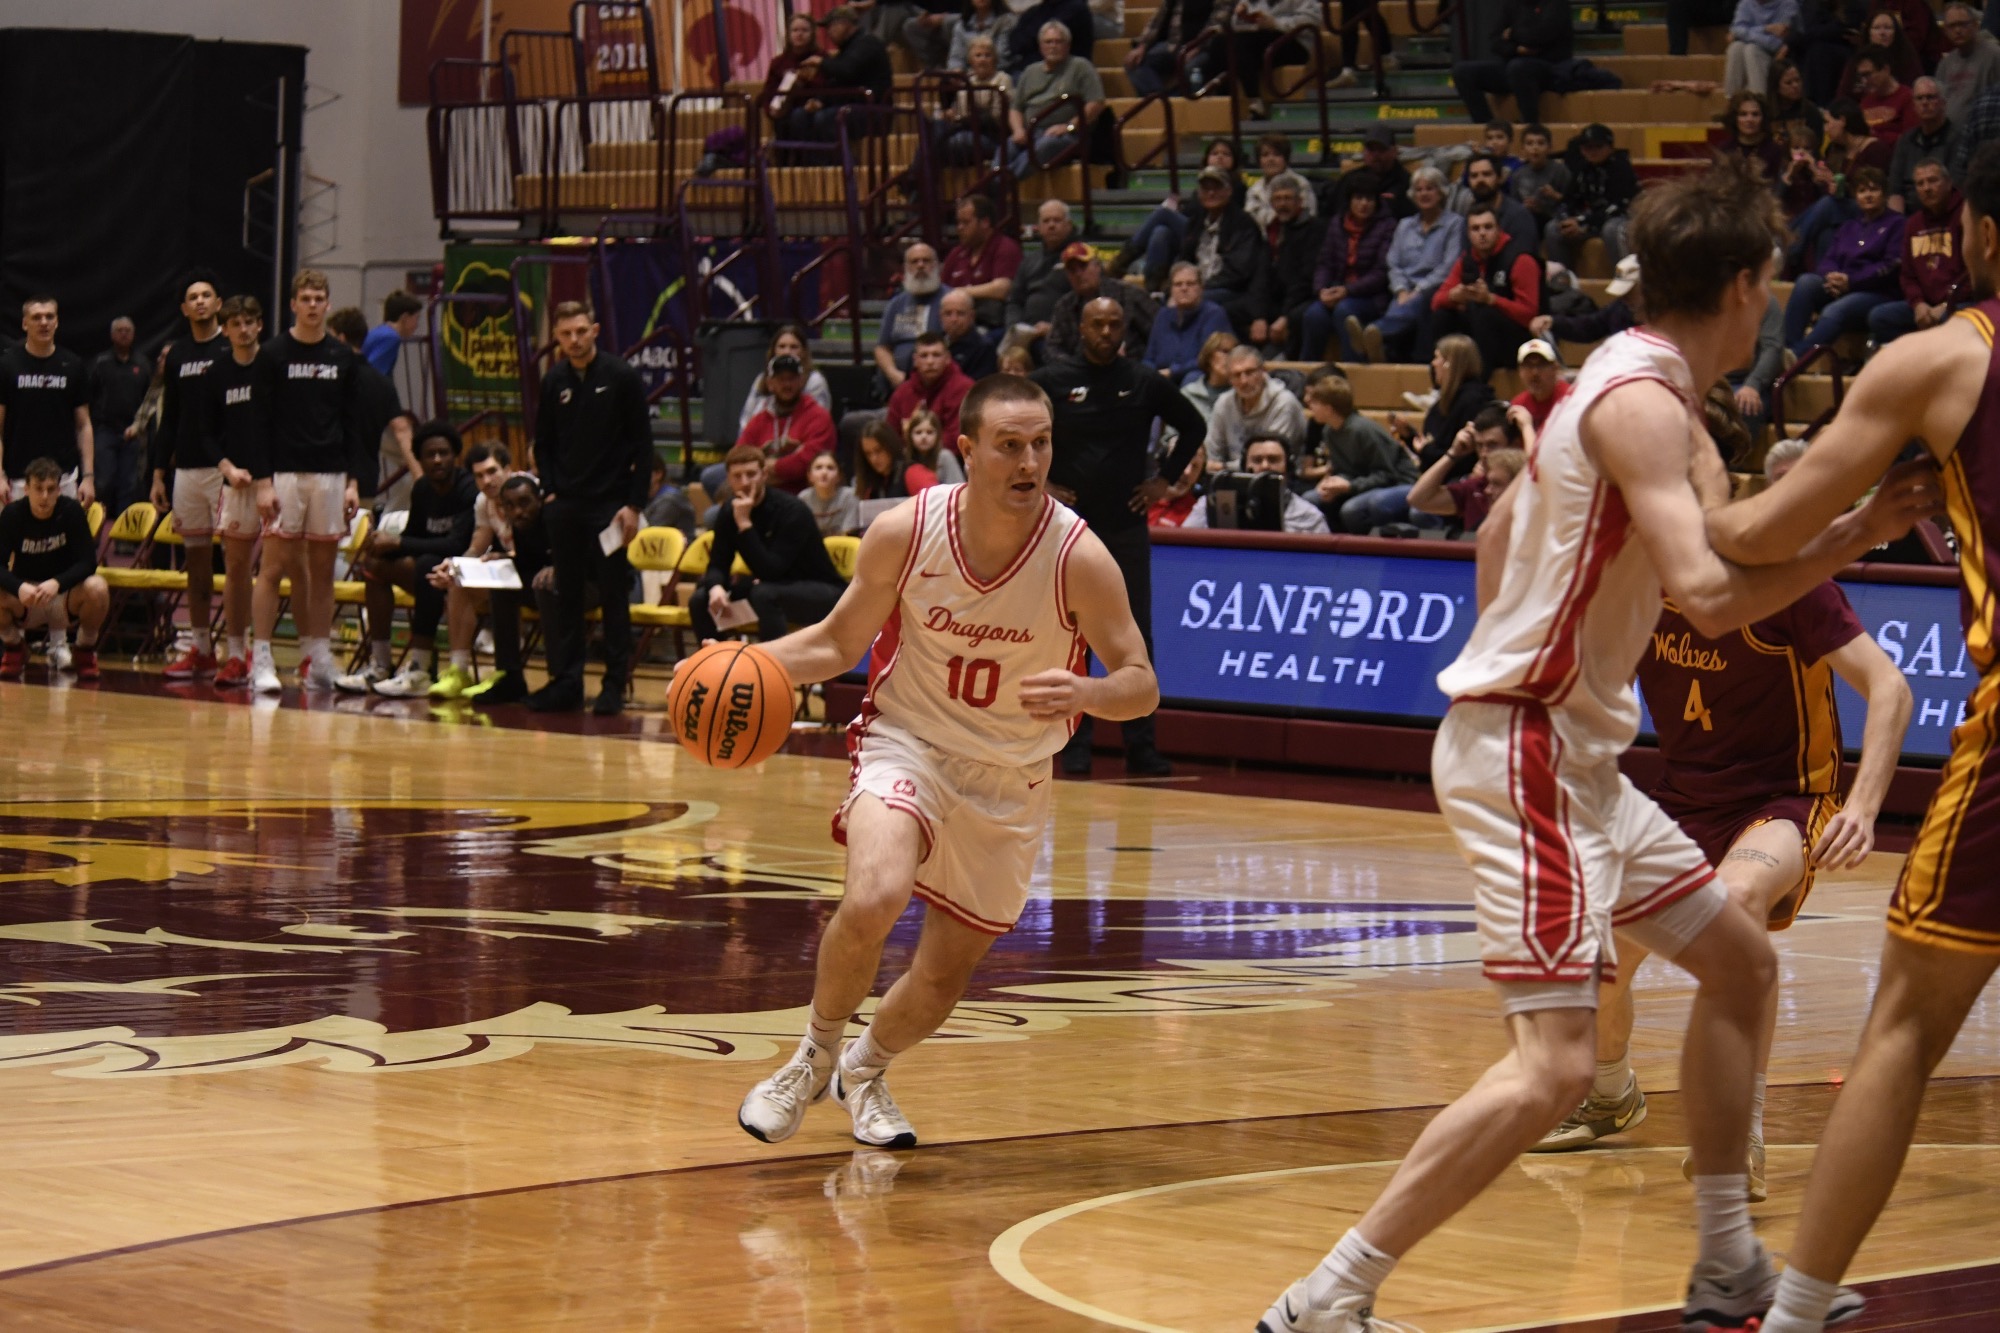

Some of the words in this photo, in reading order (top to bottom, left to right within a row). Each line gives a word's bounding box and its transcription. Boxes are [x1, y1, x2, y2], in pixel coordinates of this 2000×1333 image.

[119, 508, 151, 535] NSU
[635, 537, 667, 558] NSU
[831, 544, 850, 569] SU
[923, 605, 1035, 648] Dragons
[1180, 579, 1456, 644] SANFORD
[1218, 649, 1385, 687] HEALTH
[1653, 632, 1728, 671] Wolves
[946, 655, 1001, 708] 10
[685, 680, 709, 742] NCAA
[717, 683, 754, 760] Wilson
[1683, 678, 1713, 731] 4
